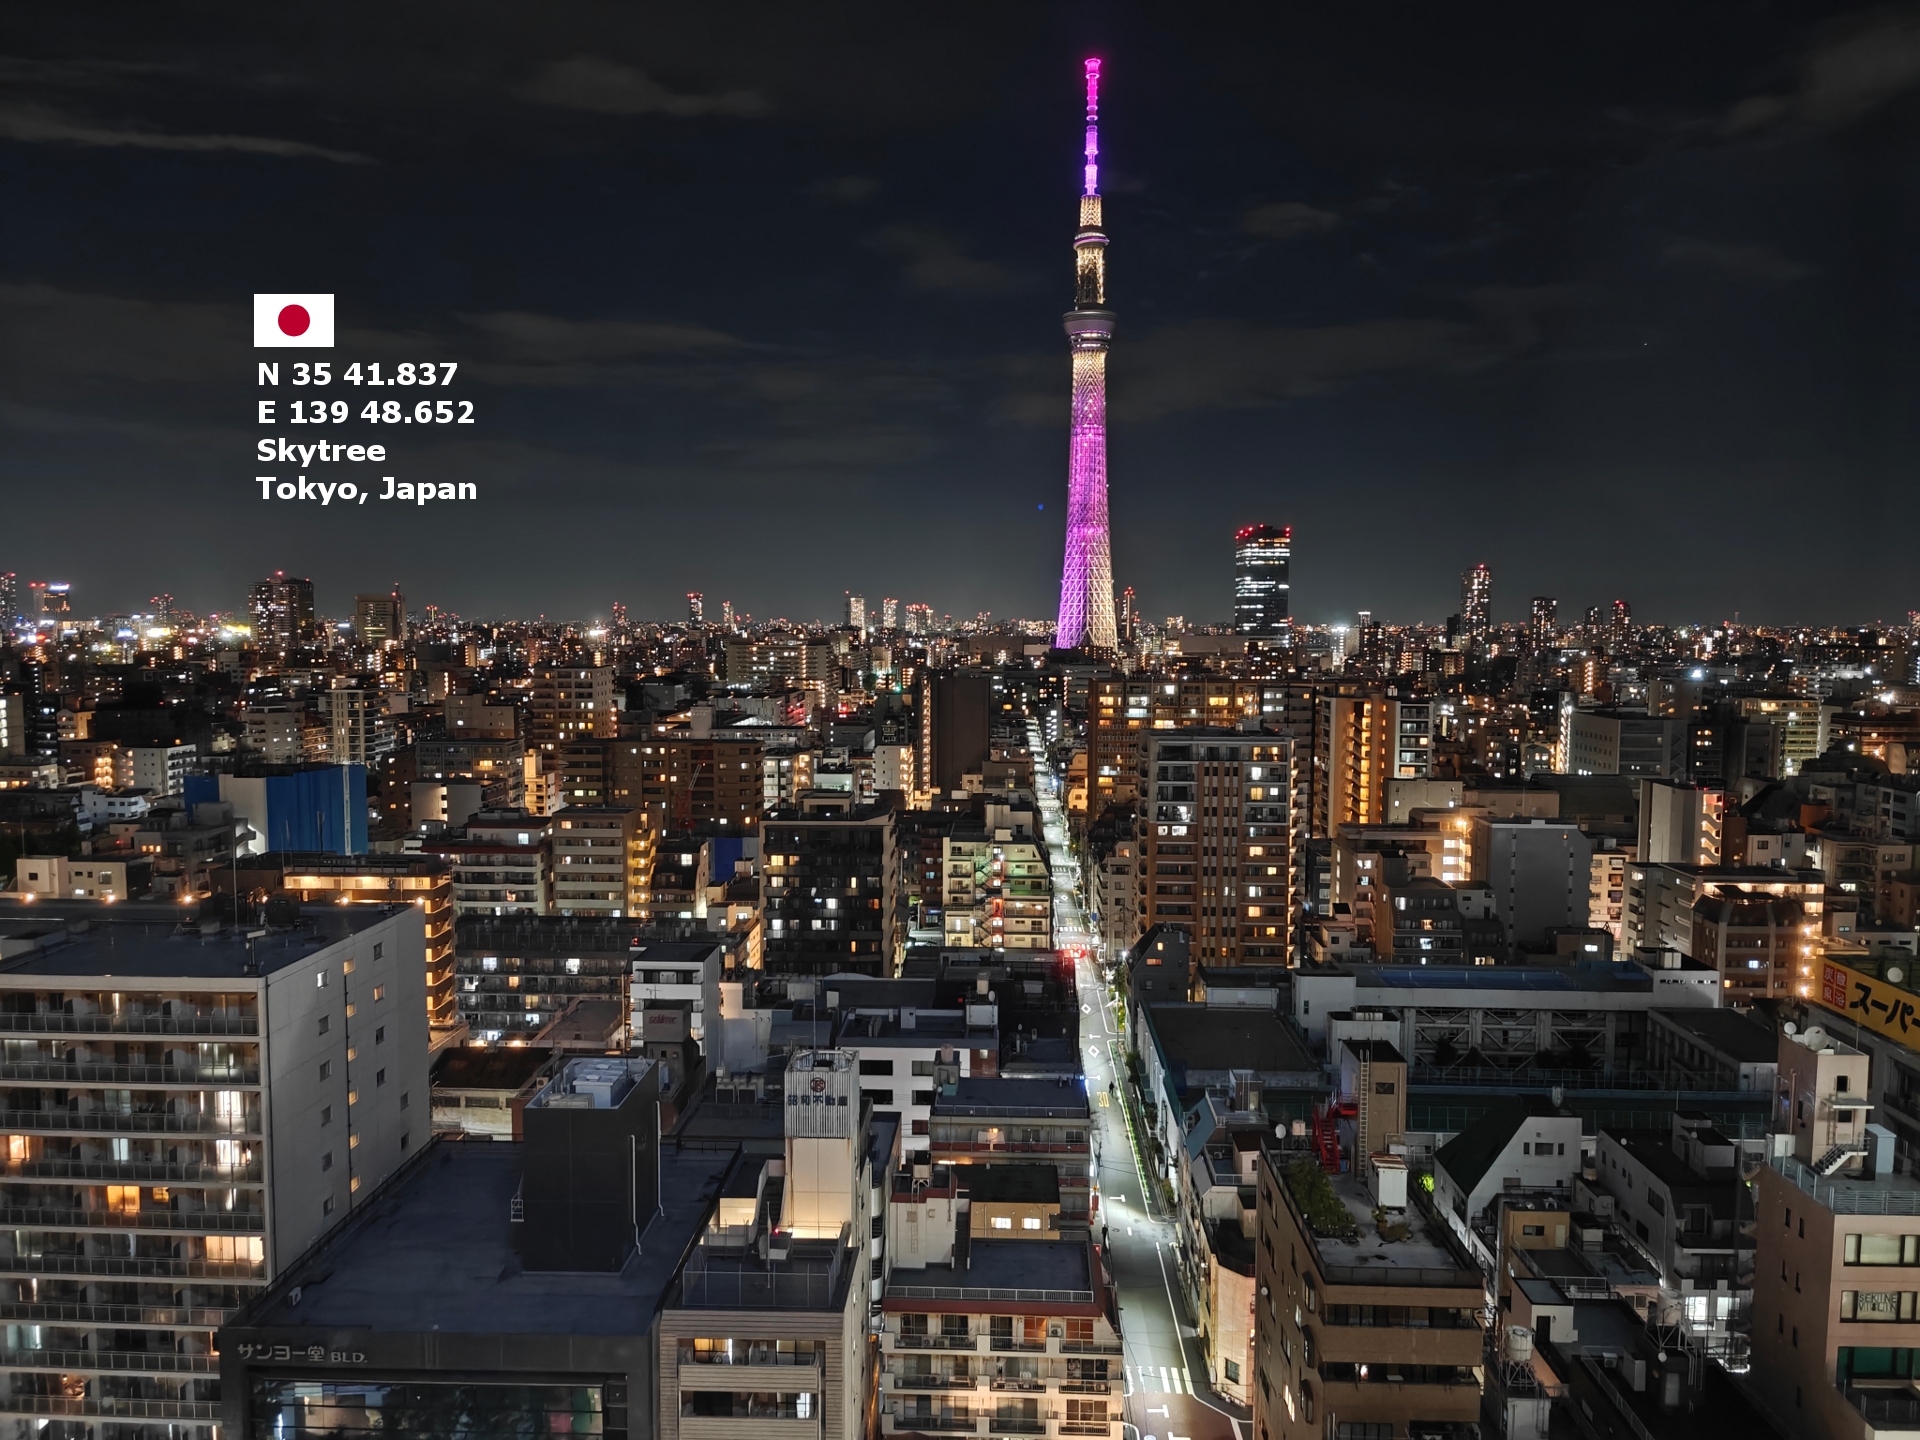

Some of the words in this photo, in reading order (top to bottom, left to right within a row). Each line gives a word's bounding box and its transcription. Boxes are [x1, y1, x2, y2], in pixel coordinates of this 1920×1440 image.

[1096, 1091, 1110, 1108] 30
[237, 1343, 324, 1362] サンヨー堂
